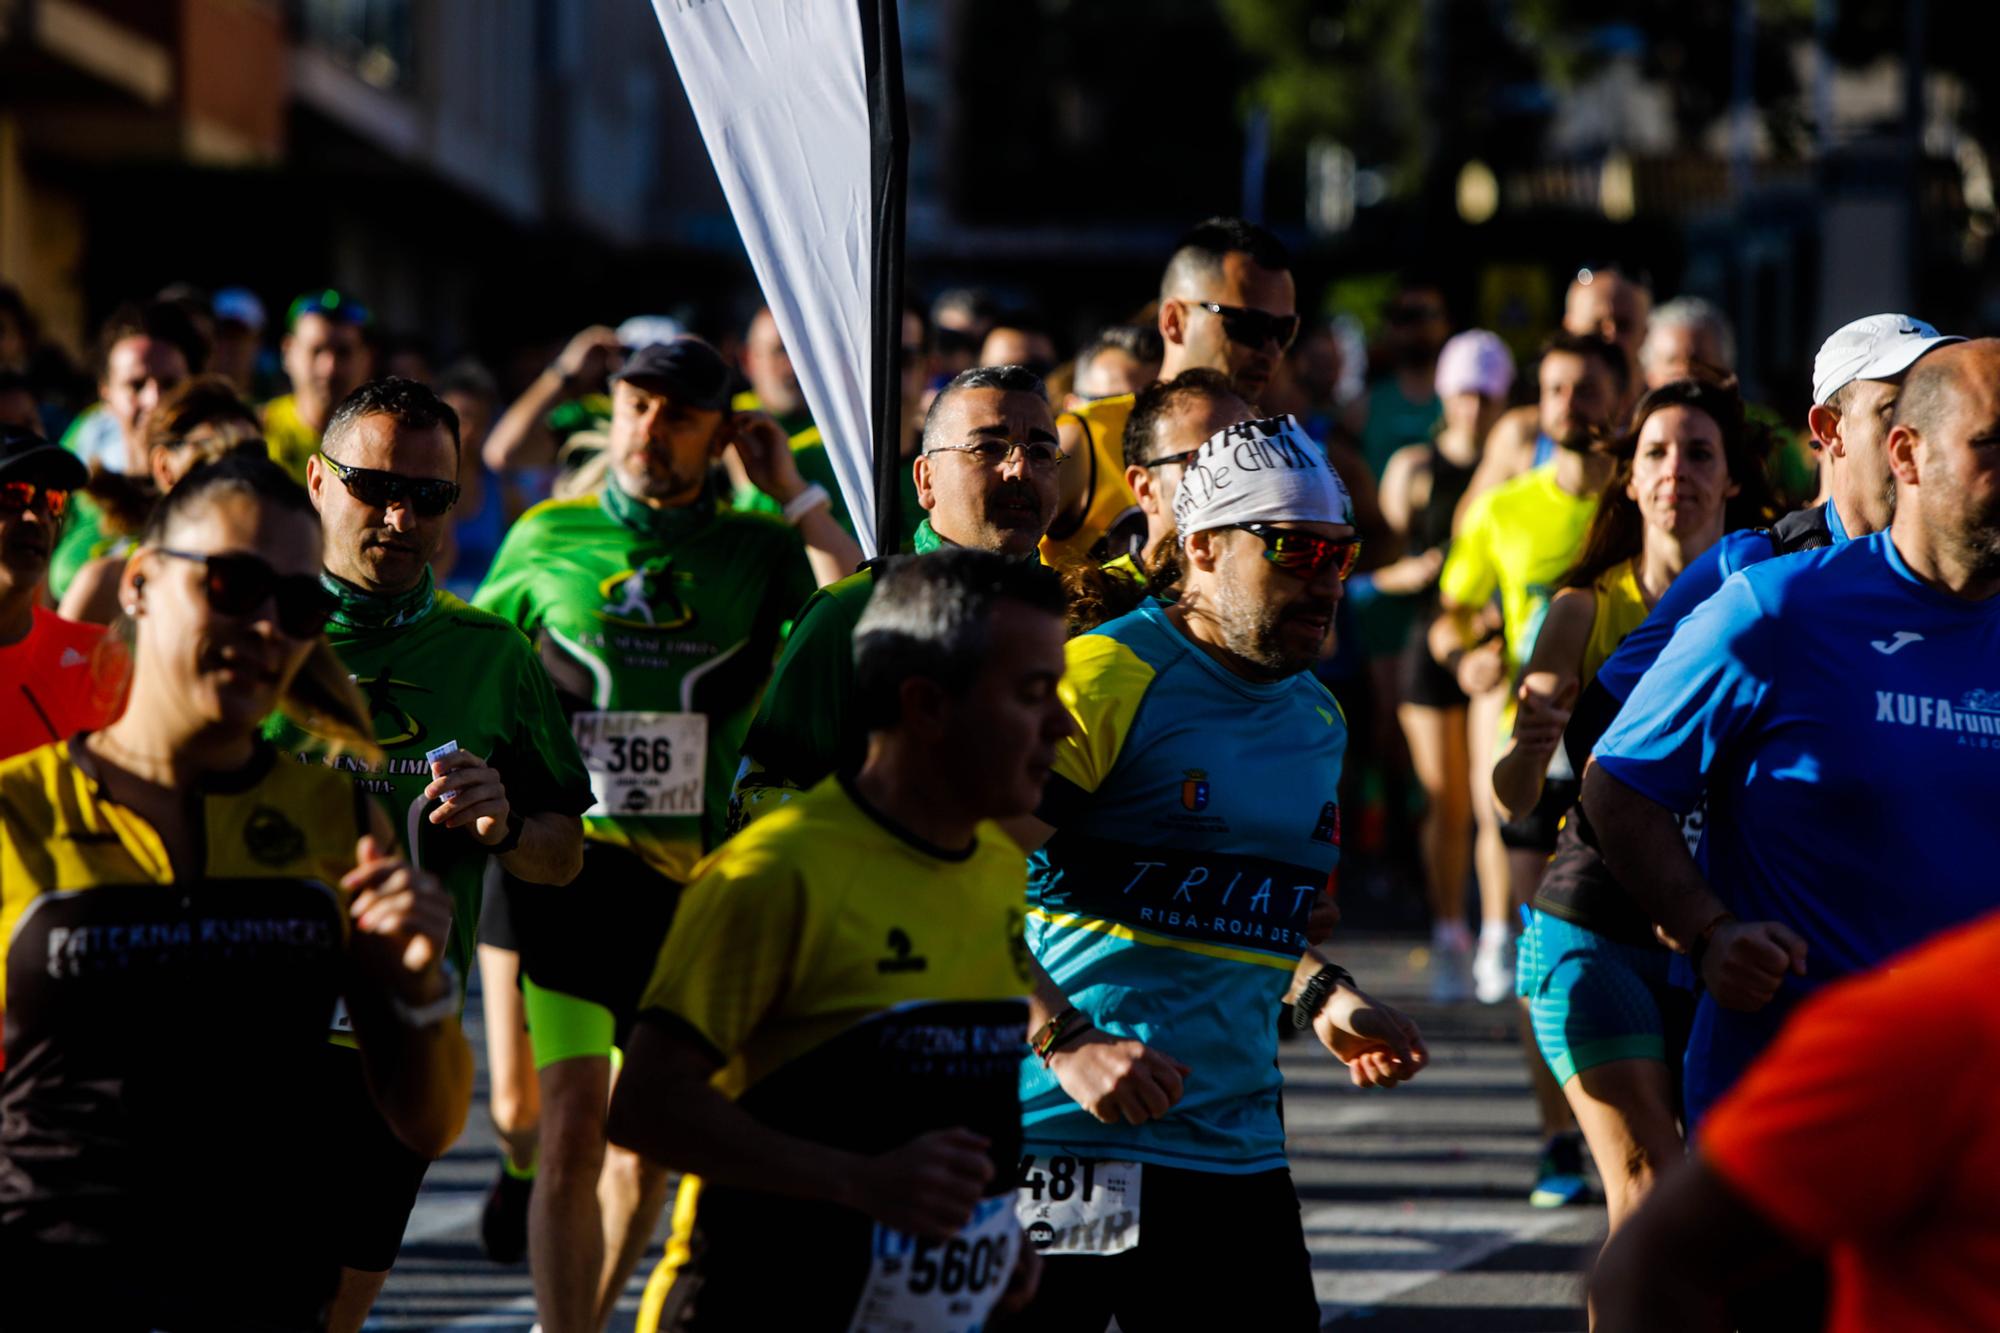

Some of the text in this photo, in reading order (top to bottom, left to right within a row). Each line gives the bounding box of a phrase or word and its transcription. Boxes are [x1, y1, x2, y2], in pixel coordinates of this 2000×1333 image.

[1198, 434, 1317, 500] De CHIVA
[389, 758, 431, 776] LIMI
[607, 736, 670, 773] 366
[1124, 861, 1315, 923] TRIAT
[1139, 906, 1264, 939] RIBA-ROJA
[1270, 927, 1289, 944] DE
